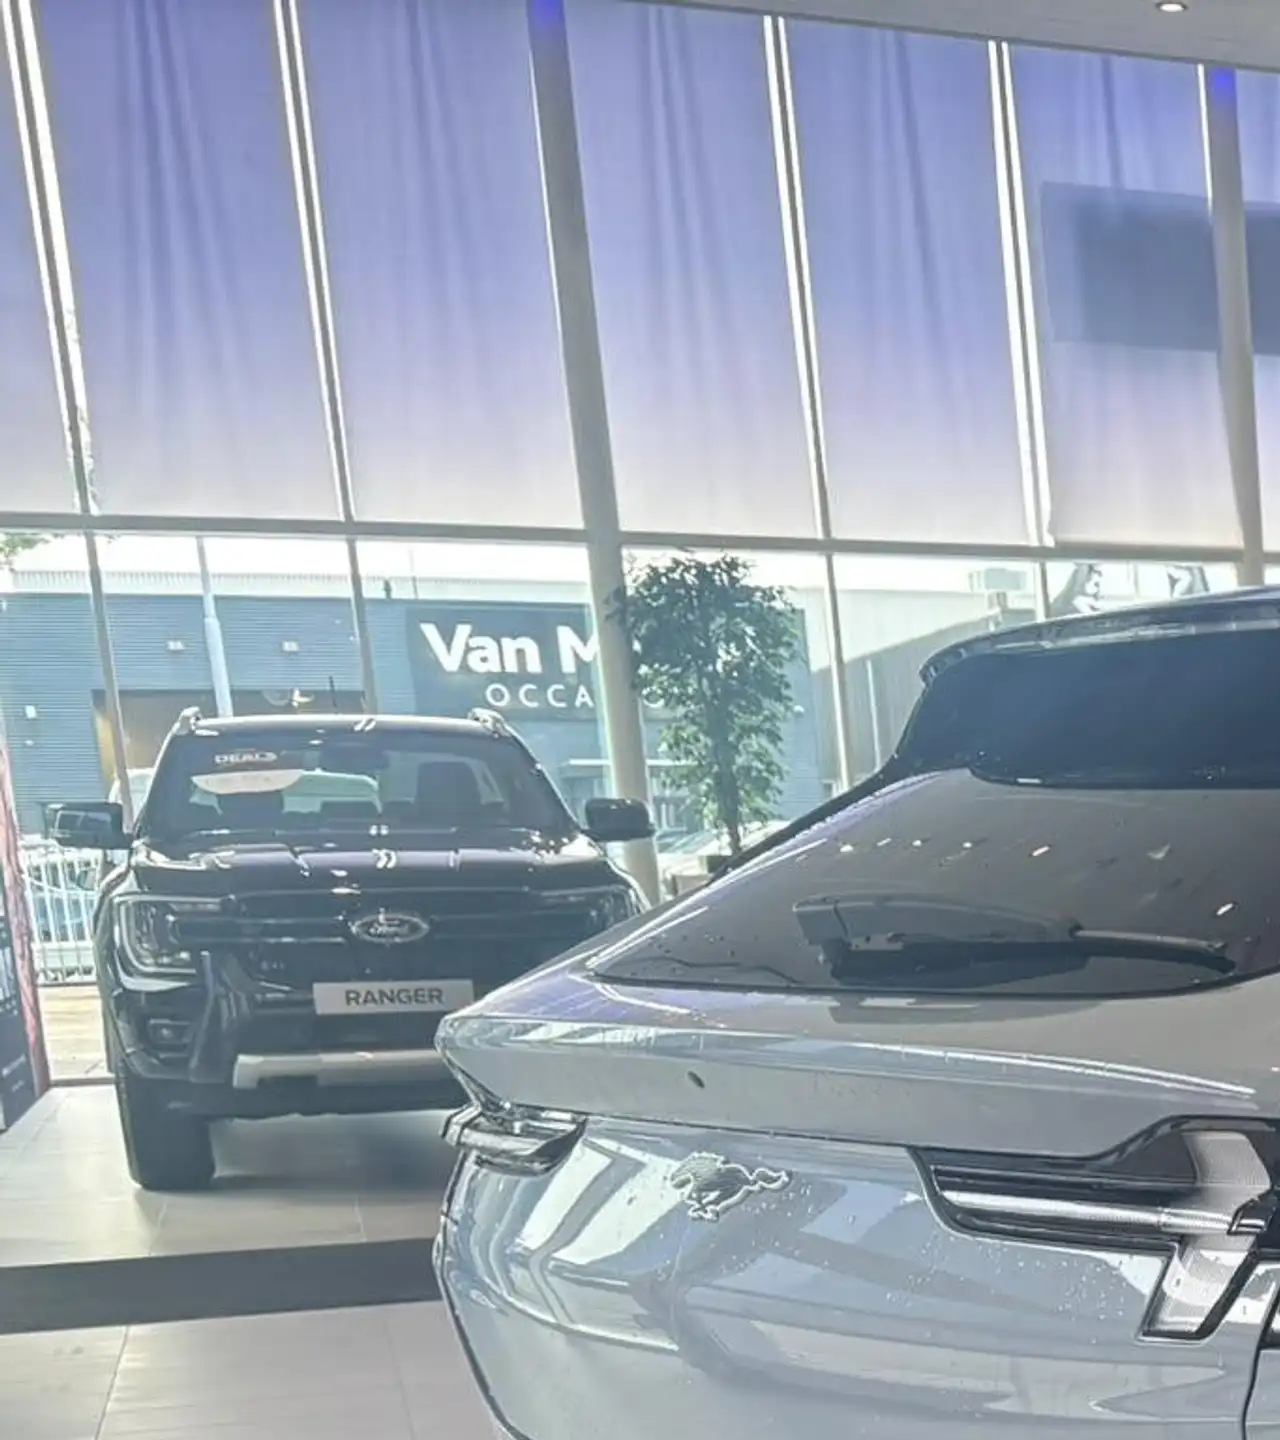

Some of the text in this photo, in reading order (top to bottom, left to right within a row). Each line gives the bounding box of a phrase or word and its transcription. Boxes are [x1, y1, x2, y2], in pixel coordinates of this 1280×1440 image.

[419, 623, 600, 674] Van M
[345, 988, 444, 1006] RANGER
